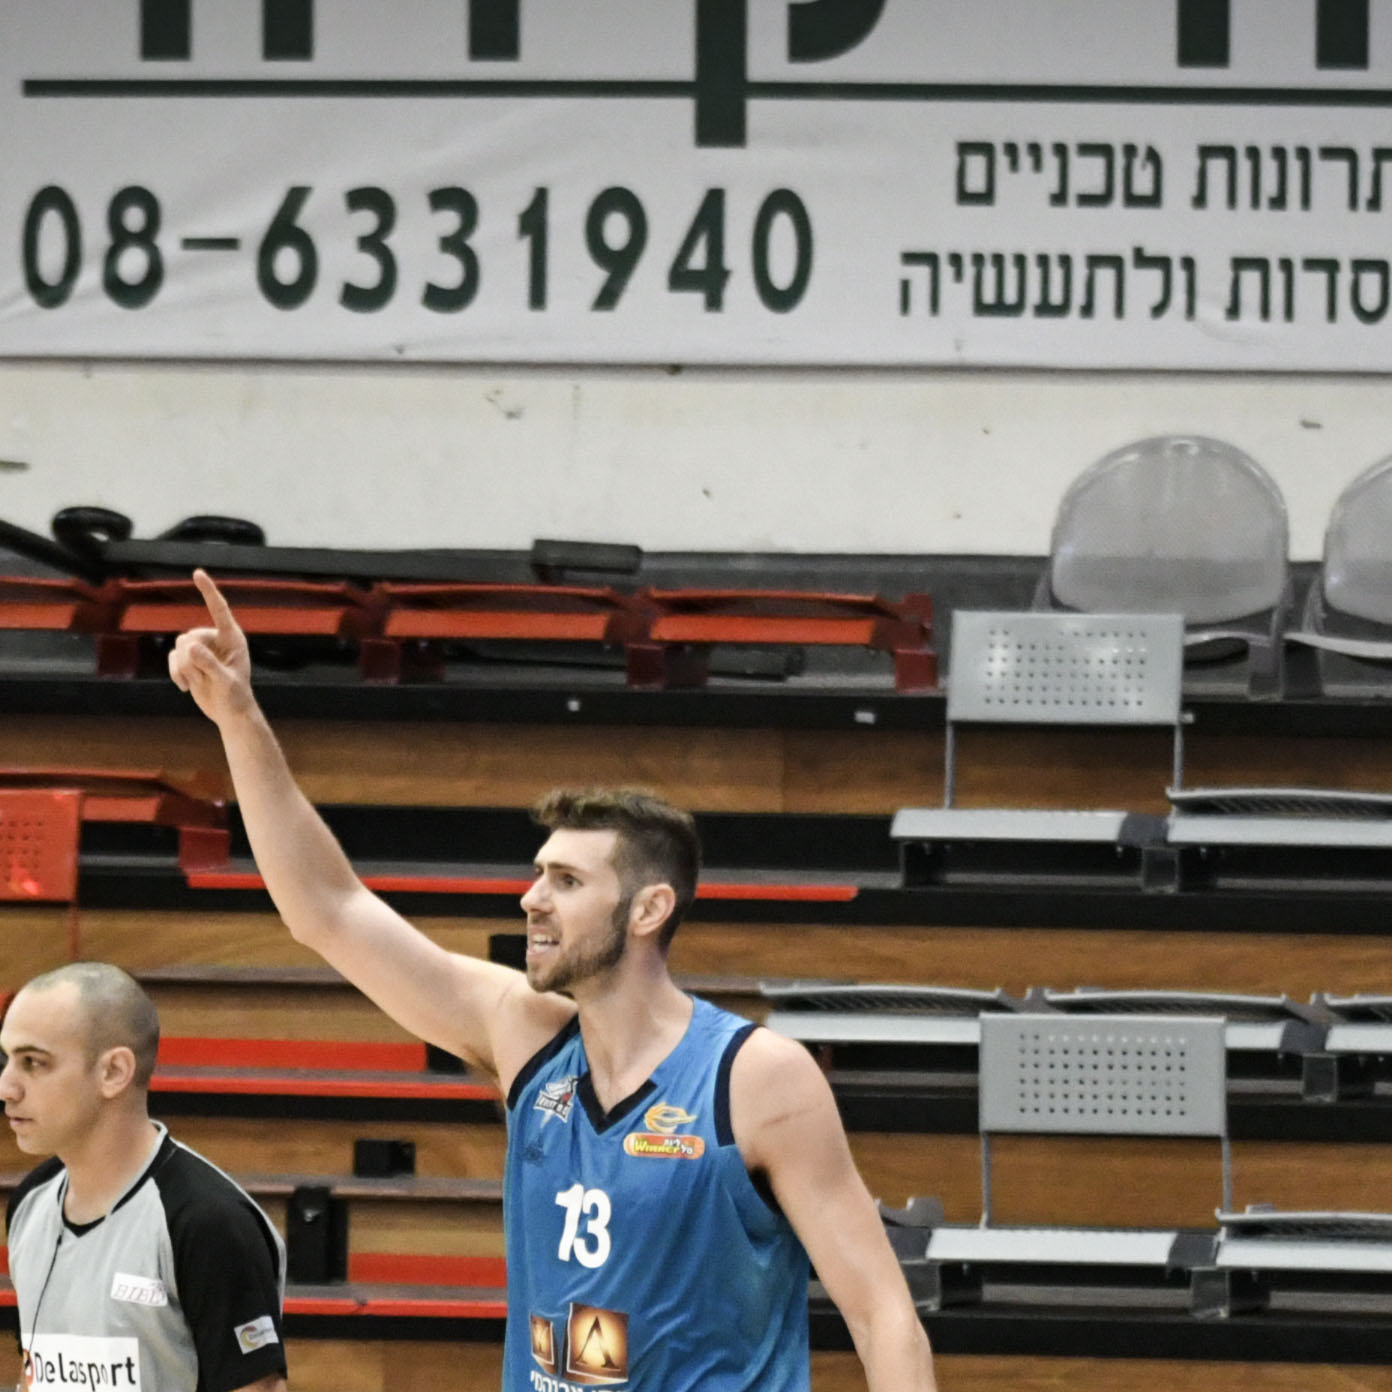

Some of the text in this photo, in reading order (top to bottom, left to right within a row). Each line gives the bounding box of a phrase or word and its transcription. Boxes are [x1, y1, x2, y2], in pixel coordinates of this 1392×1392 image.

[954, 139, 1164, 208] טכניים
[21, 183, 815, 314] 08-6331940
[898, 246, 1198, 322] ולתעשיה
[555, 1183, 611, 1269] 13
[34, 1352, 137, 1392] Delasport
